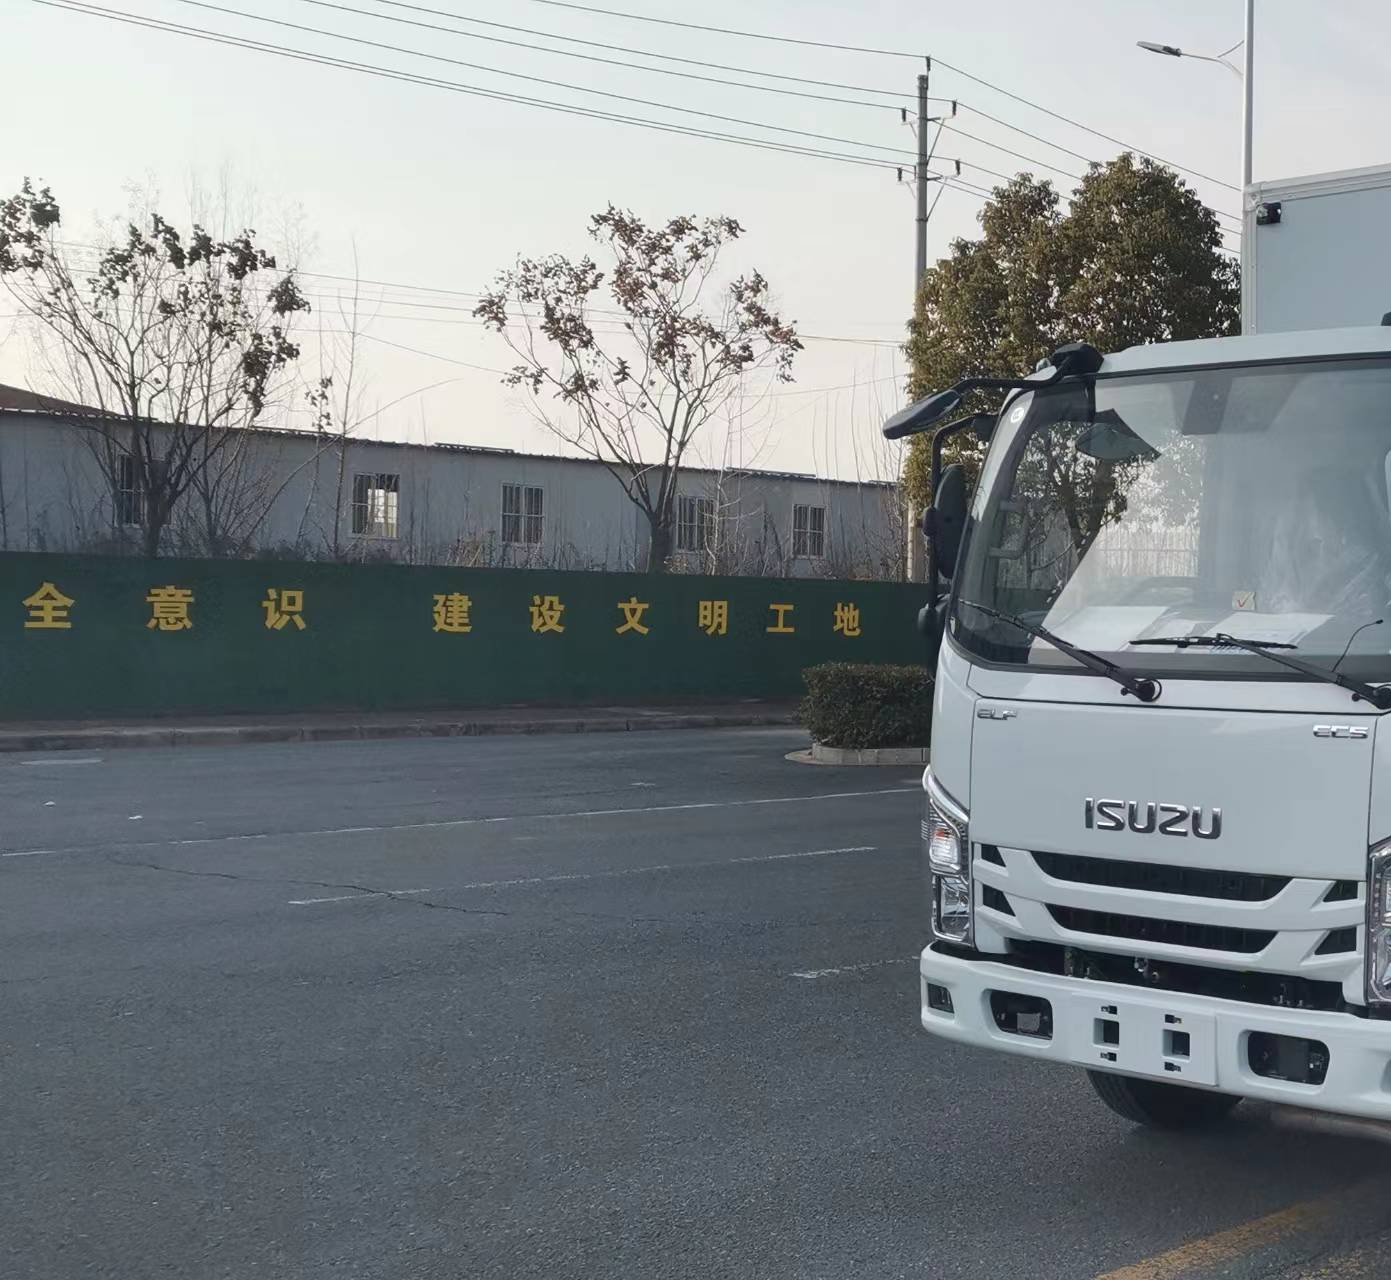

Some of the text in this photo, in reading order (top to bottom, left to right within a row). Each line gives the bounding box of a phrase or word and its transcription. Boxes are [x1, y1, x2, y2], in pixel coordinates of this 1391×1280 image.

[22, 581, 862, 637] 全意识 建设文明工地
[1085, 797, 1222, 840] ISUZU
